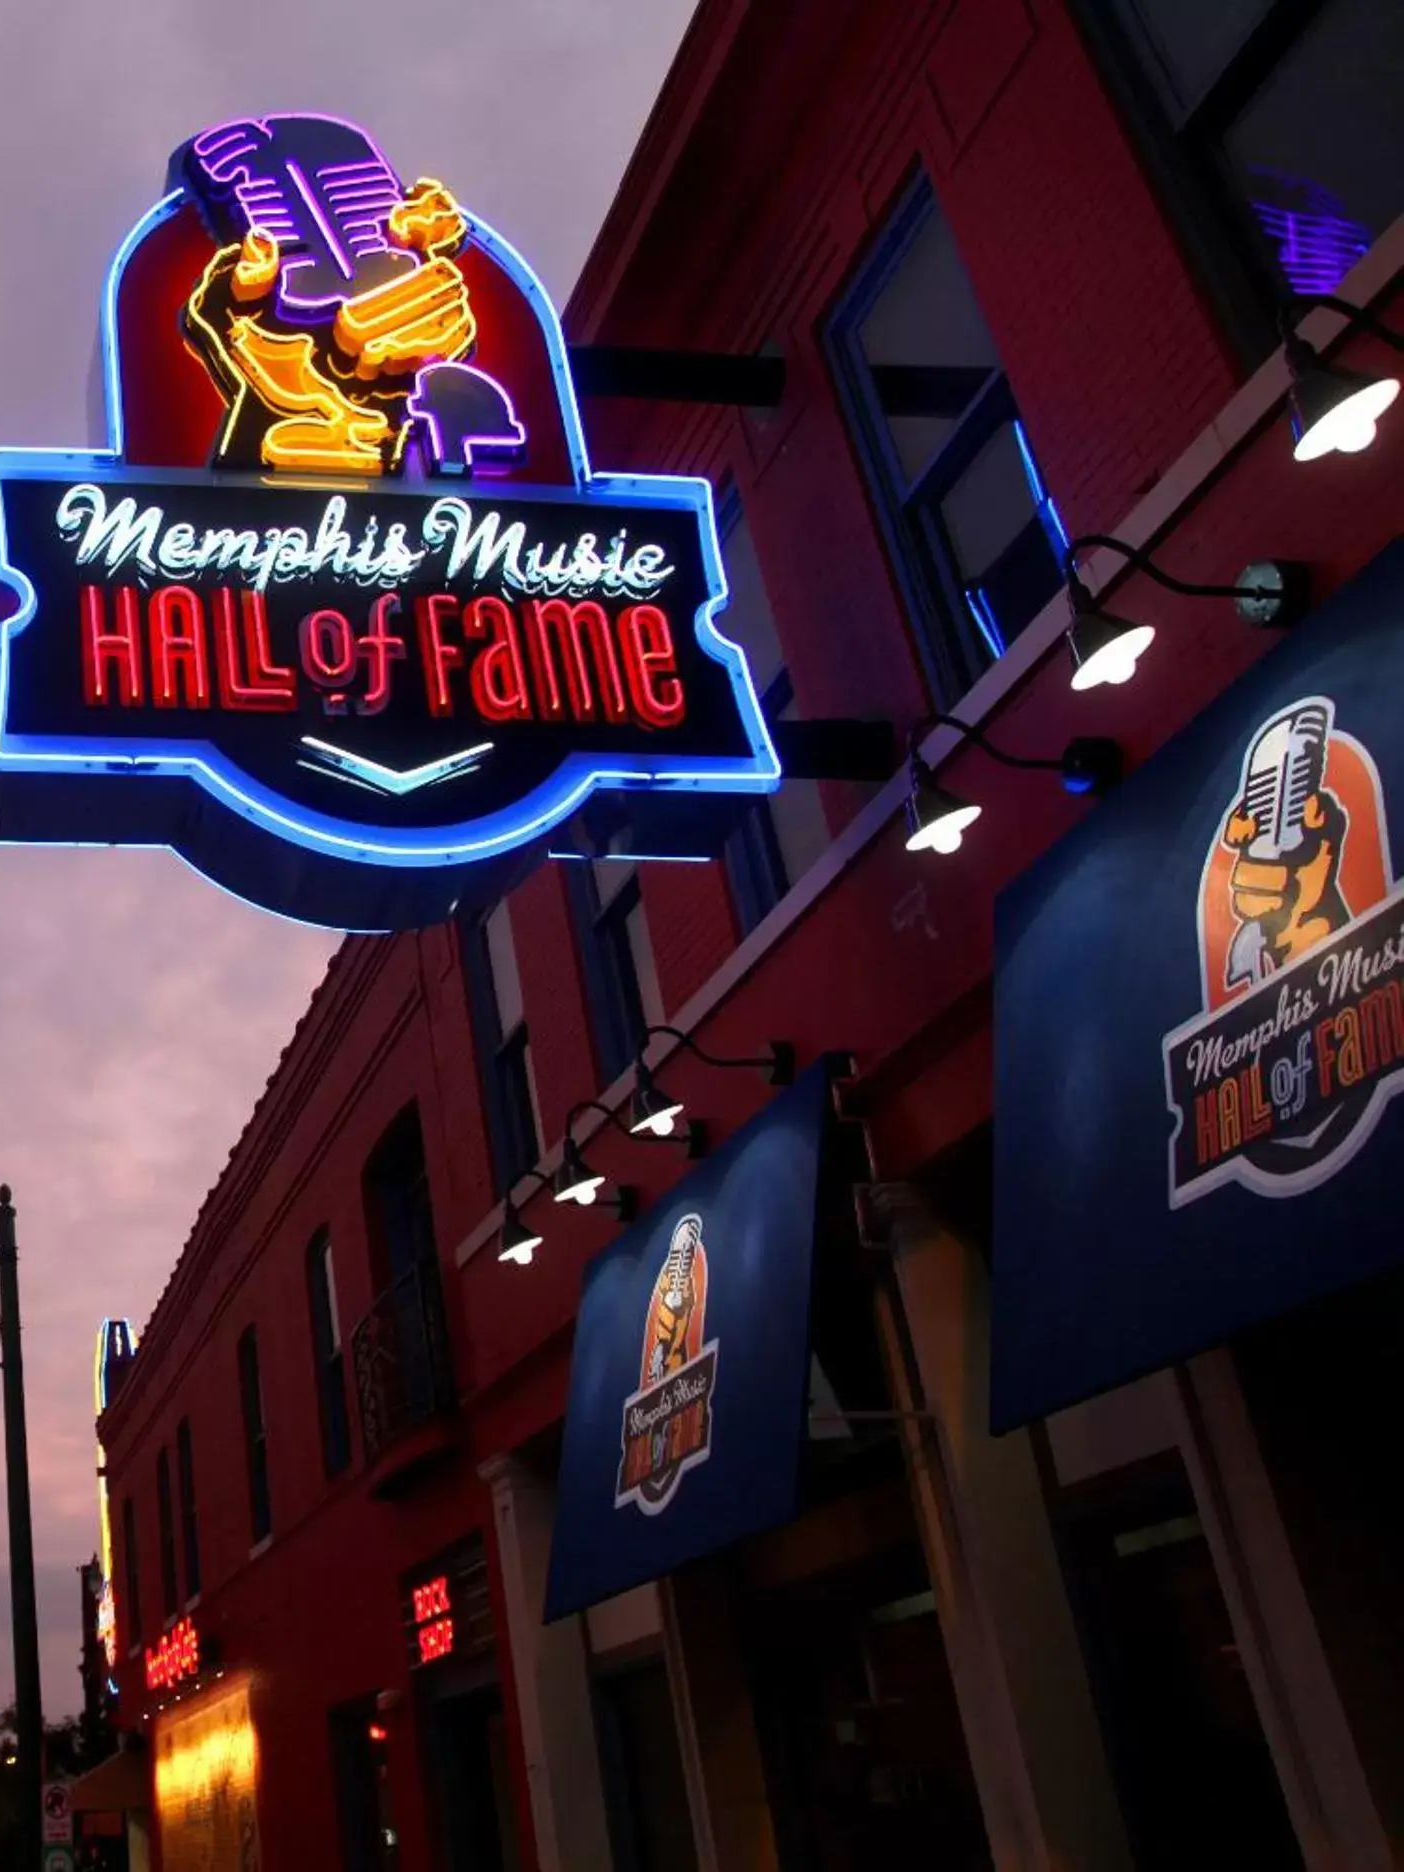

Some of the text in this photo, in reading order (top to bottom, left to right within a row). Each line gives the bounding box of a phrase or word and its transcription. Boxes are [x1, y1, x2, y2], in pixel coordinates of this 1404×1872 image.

[56, 484, 675, 596] Memphis Music
[81, 585, 686, 728] HALL of Fame
[1186, 984, 1319, 1086] Memphis
[1193, 976, 1404, 1164] HALL of Fam
[414, 1576, 450, 1622] ROCK
[419, 1617, 453, 1663] SHOP
